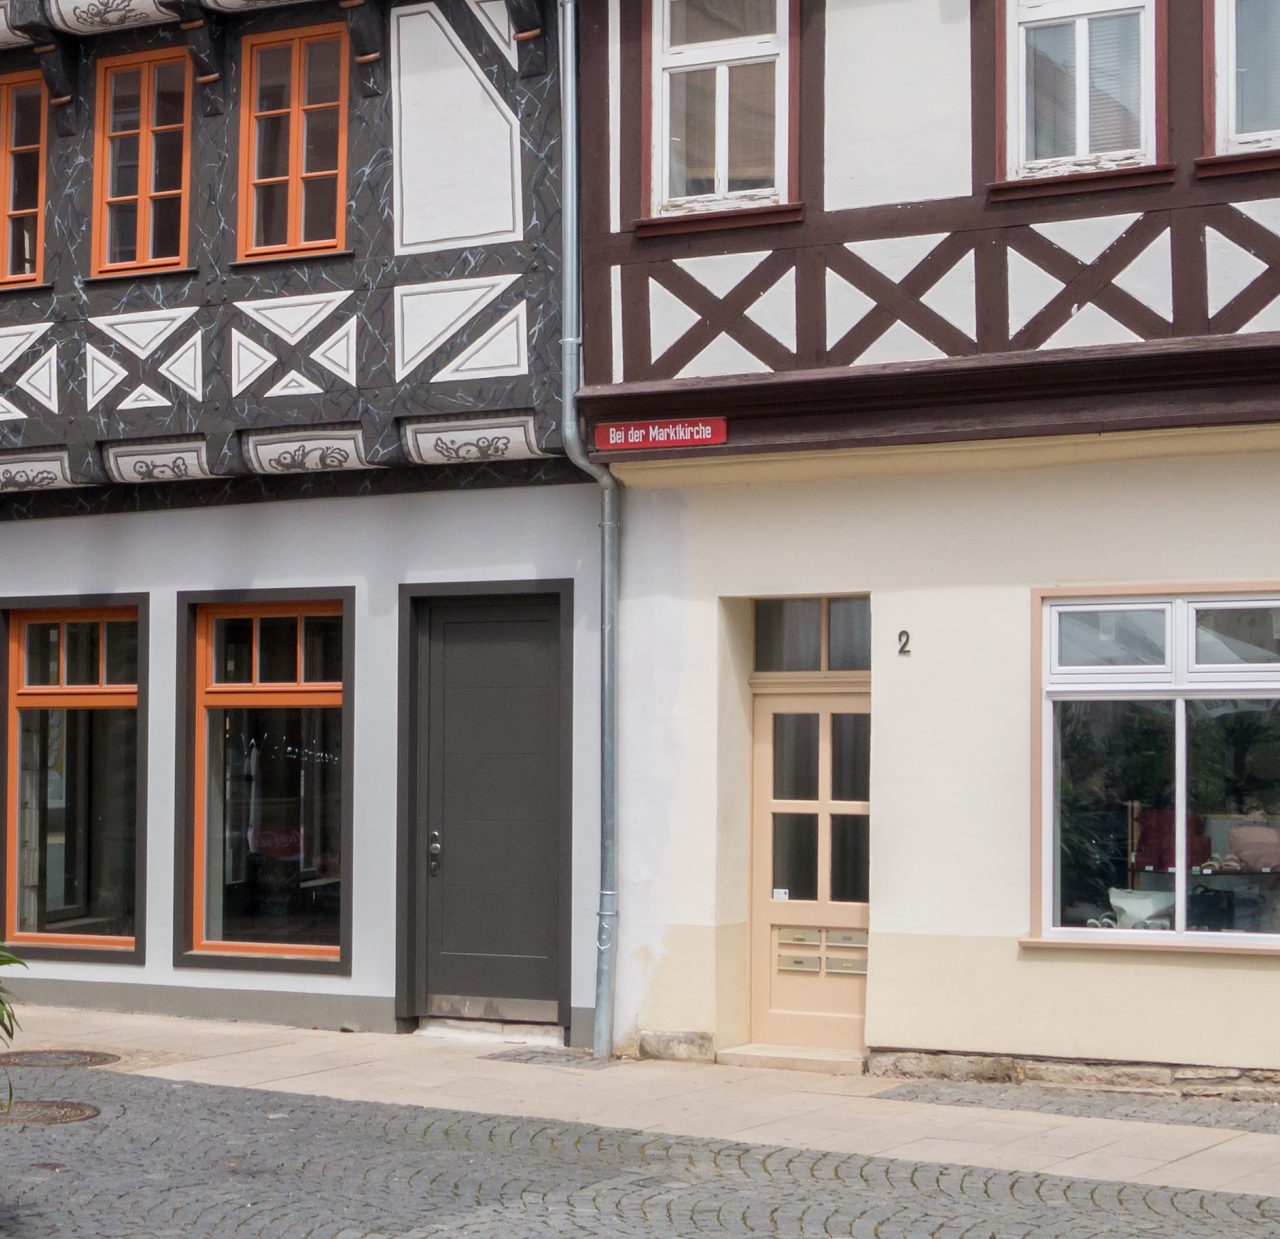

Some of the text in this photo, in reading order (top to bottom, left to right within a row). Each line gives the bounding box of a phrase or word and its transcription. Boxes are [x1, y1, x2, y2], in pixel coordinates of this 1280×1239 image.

[609, 423, 712, 444] Bei der Marktkirche
[898, 630, 911, 655] 2
